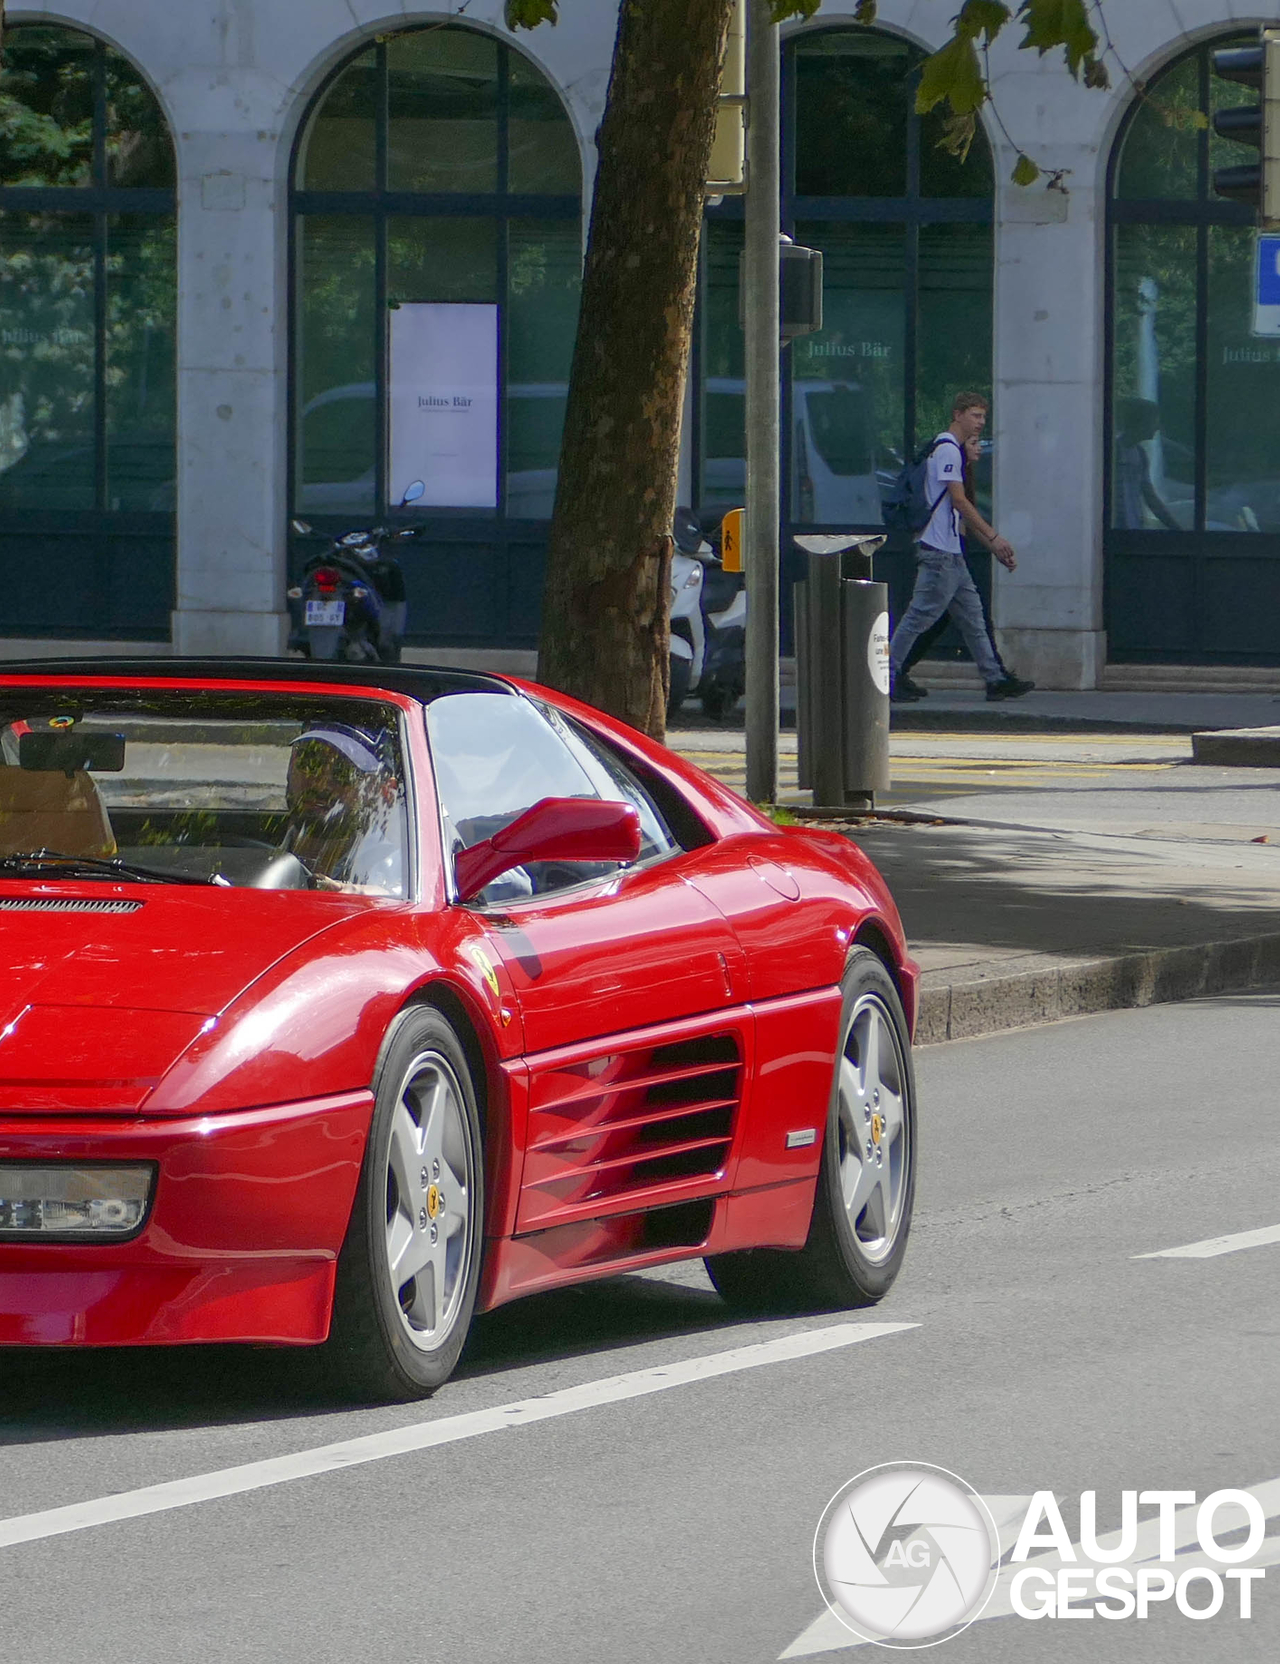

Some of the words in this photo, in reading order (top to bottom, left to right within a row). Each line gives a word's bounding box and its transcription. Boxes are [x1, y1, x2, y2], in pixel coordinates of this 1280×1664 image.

[808, 341, 855, 358] Julius
[861, 341, 892, 357] Bär
[1222, 346, 1271, 365] Julius
[418, 395, 450, 408] Julius
[453, 396, 474, 407] Bär
